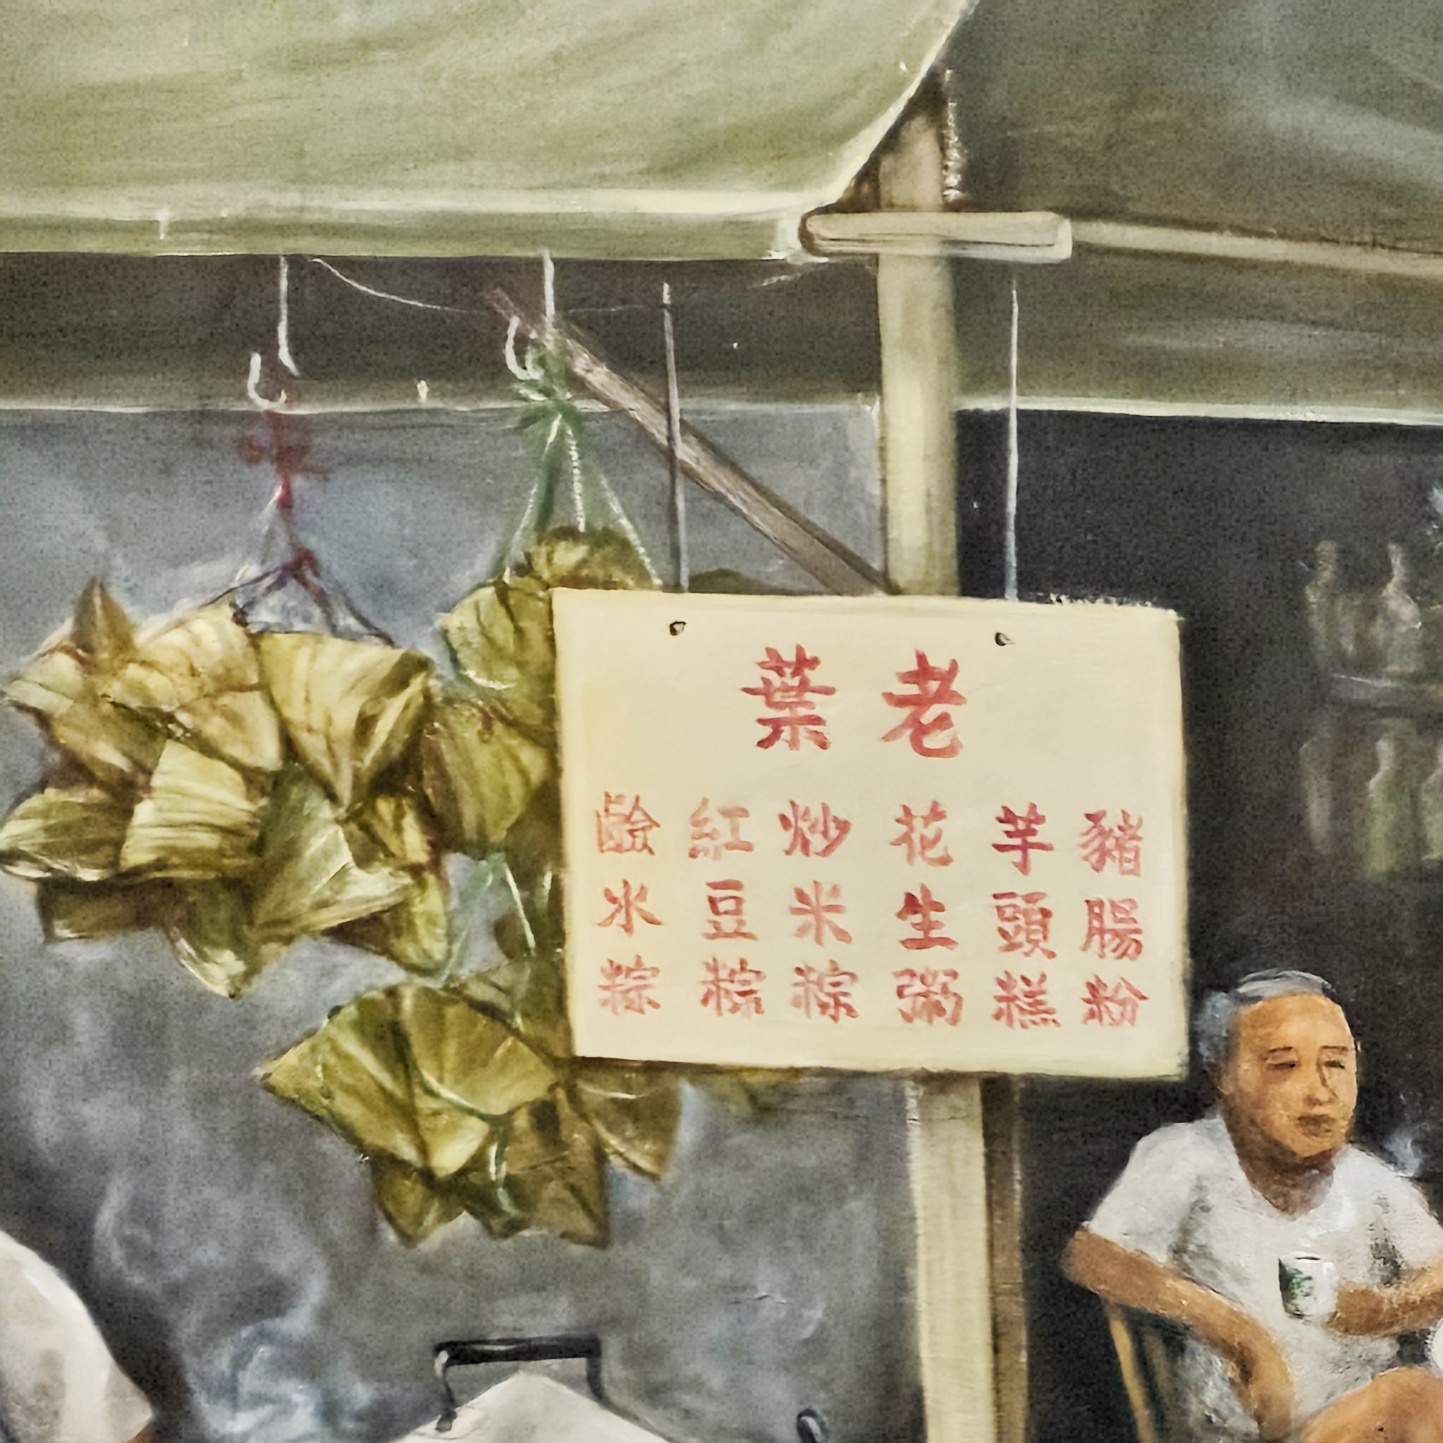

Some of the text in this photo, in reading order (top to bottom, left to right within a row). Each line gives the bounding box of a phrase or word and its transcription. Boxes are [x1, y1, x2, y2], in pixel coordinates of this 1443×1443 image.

[740, 644, 968, 759] 老葉
[688, 796, 767, 1018] 紅豆粽
[991, 802, 1061, 1030] 芋頭糕
[1078, 809, 1149, 1028] 豬腸粉
